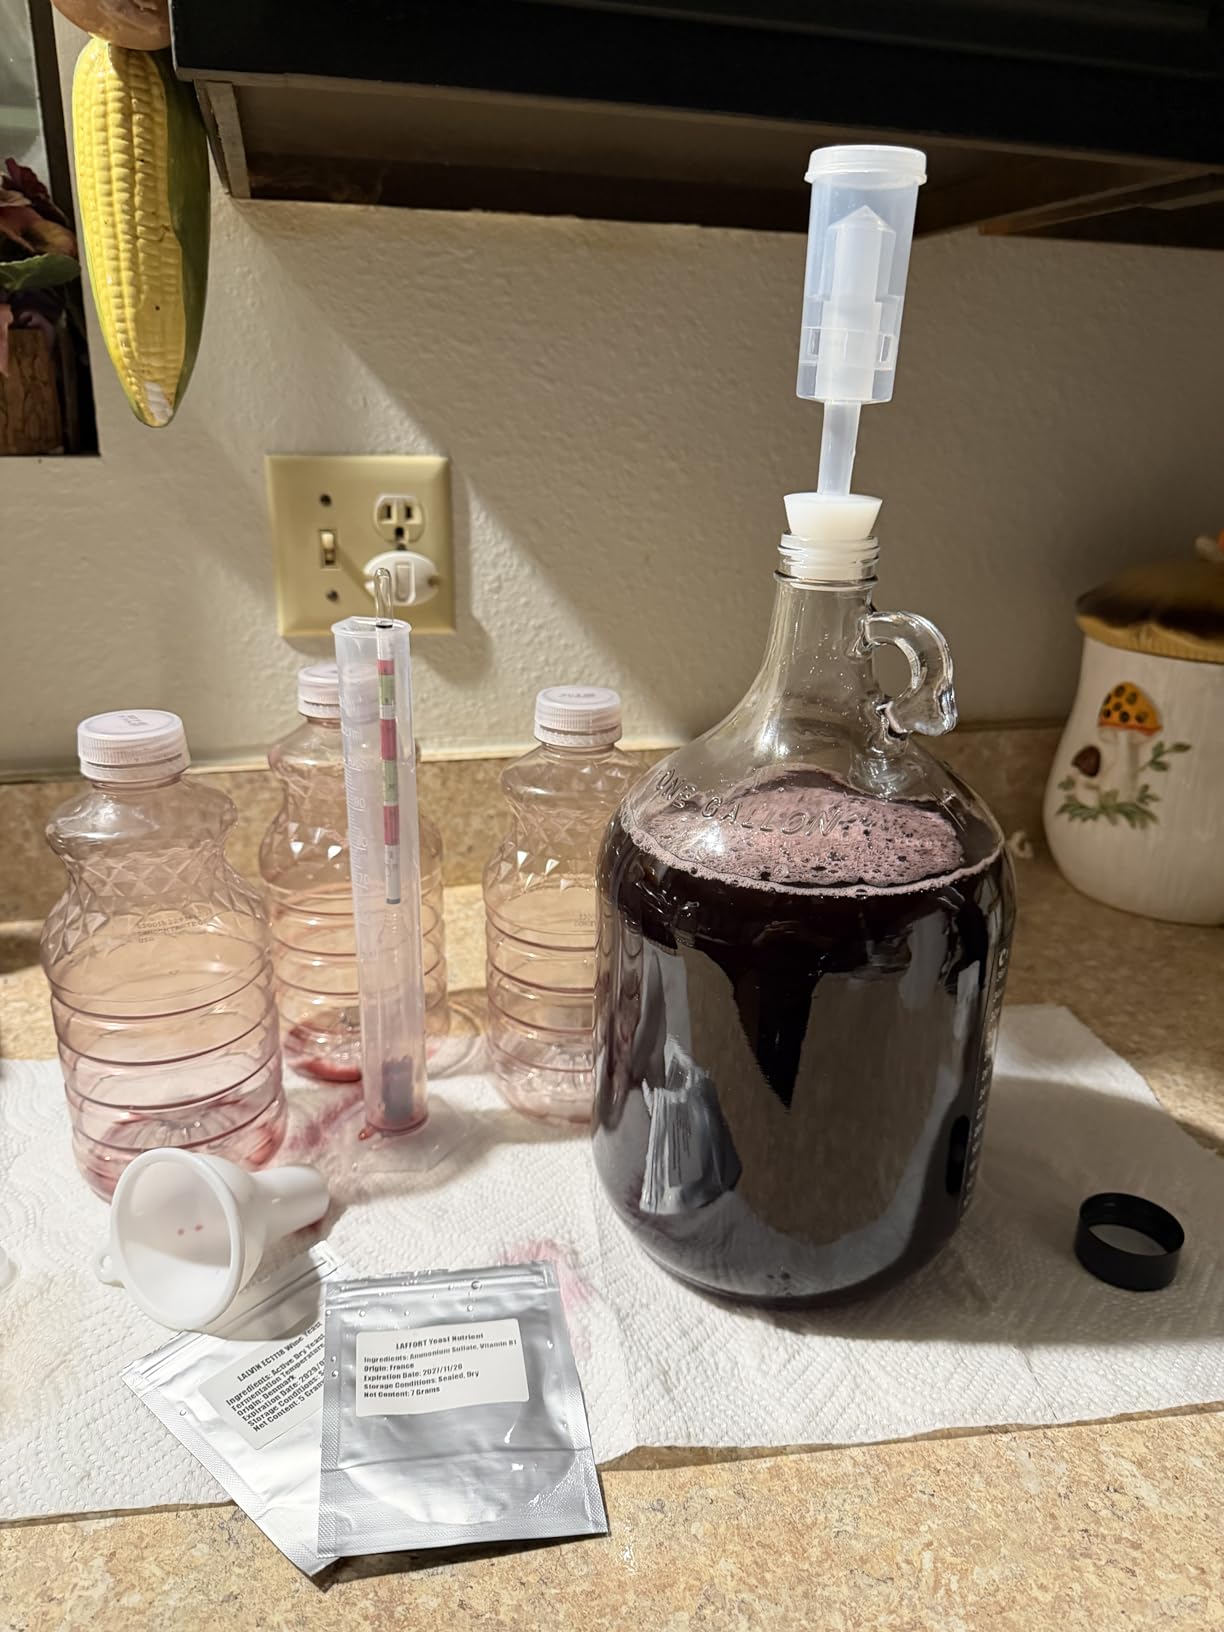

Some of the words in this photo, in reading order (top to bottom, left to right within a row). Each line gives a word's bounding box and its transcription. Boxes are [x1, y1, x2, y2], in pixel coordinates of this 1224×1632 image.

[701, 797, 842, 837] GALLON
[364, 1354, 409, 1364] Ingredients:
[480, 1341, 507, 1349] Vitamin
[396, 1339, 427, 1350] LAFFORT
[429, 1336, 450, 1345] Yeast
[452, 1333, 484, 1341] Nutrient
[237, 1362, 262, 1382] LALVIN
[261, 1349, 286, 1367] EC1118
[284, 1336, 304, 1351] Wine
[364, 1364, 389, 1373] Origin:
[390, 1363, 414, 1371] France
[225, 1372, 273, 1406] Ingredients:
[271, 1358, 295, 1376] Active
[293, 1347, 307, 1361] Dry
[364, 1373, 401, 1382] Expiration
[402, 1371, 421, 1379] Date:
[411, 1389, 415, 1397] 7
[416, 1386, 441, 1396] Grams
[438, 1372, 466, 1382] Sealed,
[467, 1370, 479, 1378] Dry
[231, 1377, 281, 1412] Fermentation
[237, 1396, 264, 1417] Origin:
[262, 1374, 296, 1400] Denmark
[242, 1393, 281, 1421] Expiration
[279, 1381, 301, 1400] Date:
[247, 1405, 279, 1427] Storage
[277, 1376, 321, 1407] Conditions:
[252, 1420, 268, 1432] Net
[267, 1400, 300, 1423] Content:
